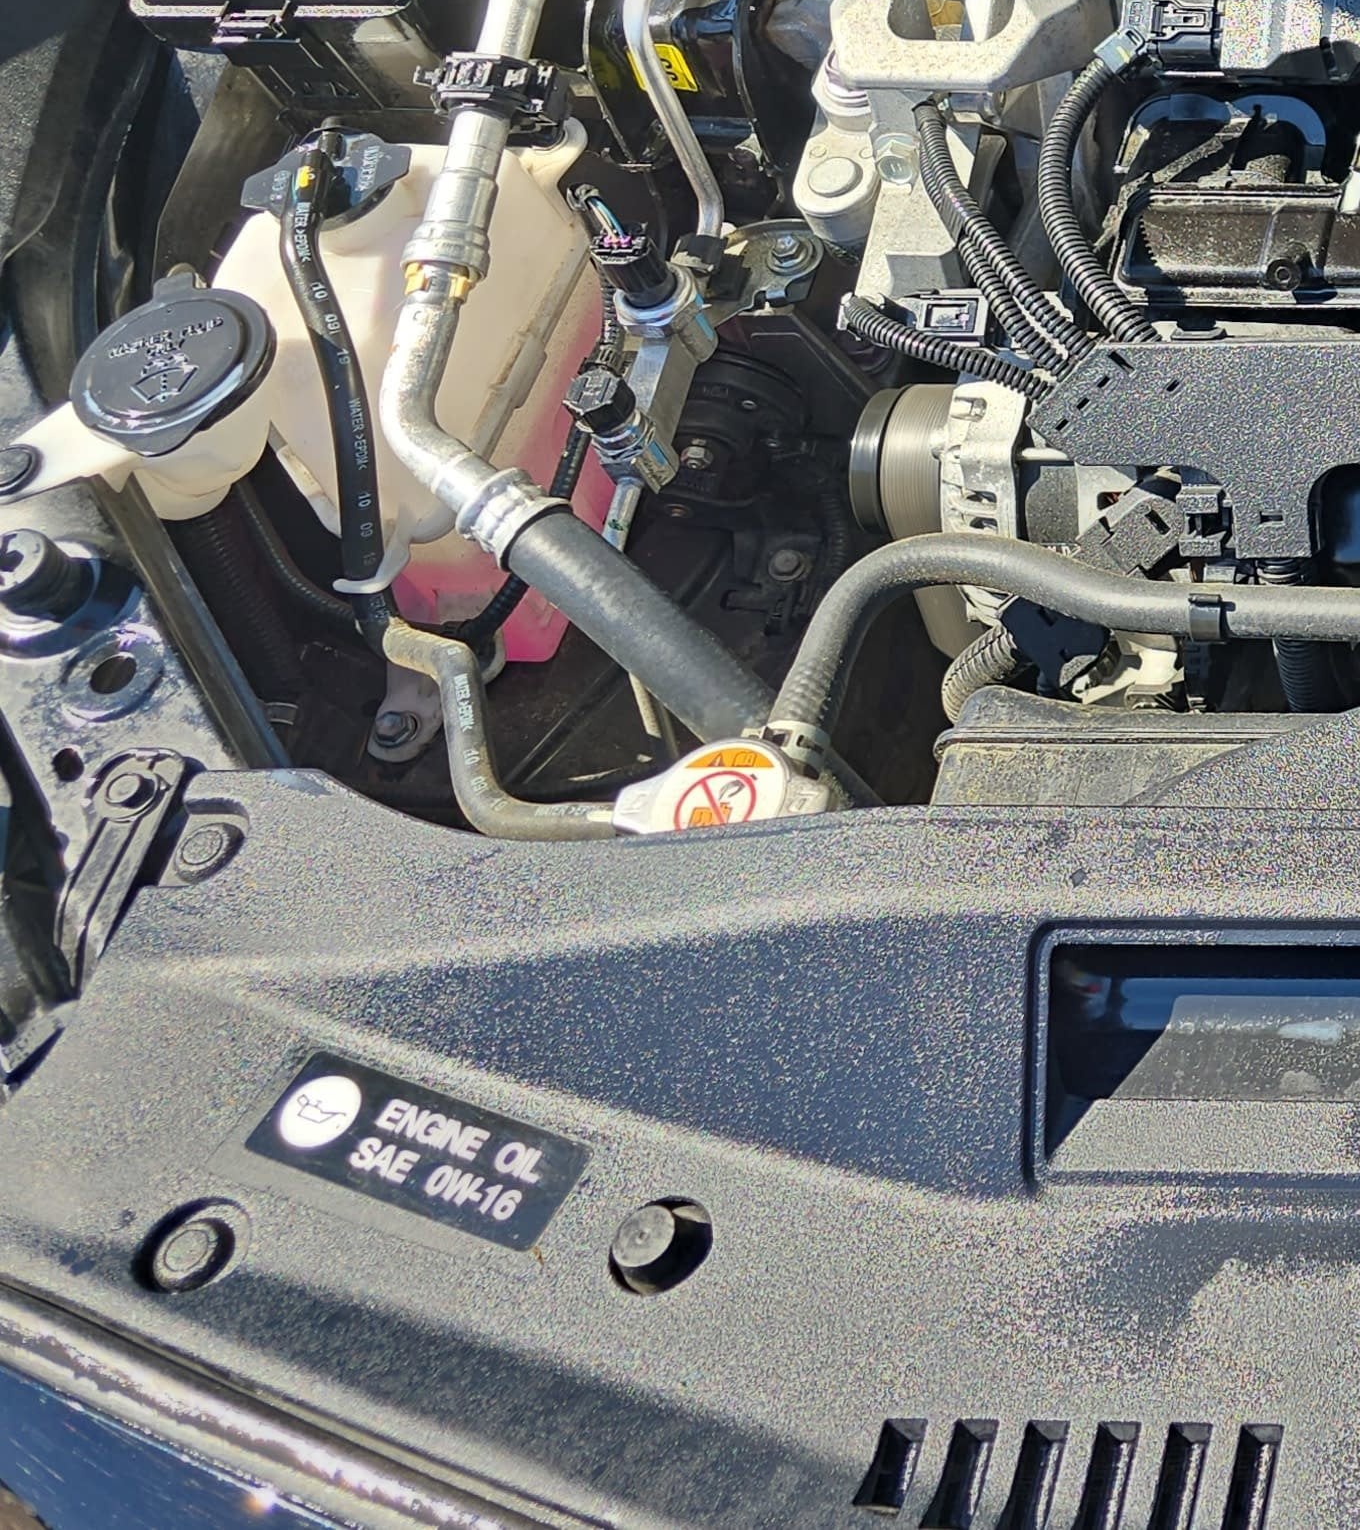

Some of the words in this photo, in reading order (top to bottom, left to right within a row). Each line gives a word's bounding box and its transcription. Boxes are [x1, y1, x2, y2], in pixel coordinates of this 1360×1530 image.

[347, 397, 364, 436] WATER
[357, 492, 371, 510] 10
[349, 1137, 415, 1184] SAE
[424, 1163, 524, 1221] 0W-16
[373, 1097, 490, 1164] ENGINE
[493, 1140, 544, 1185] OIL
